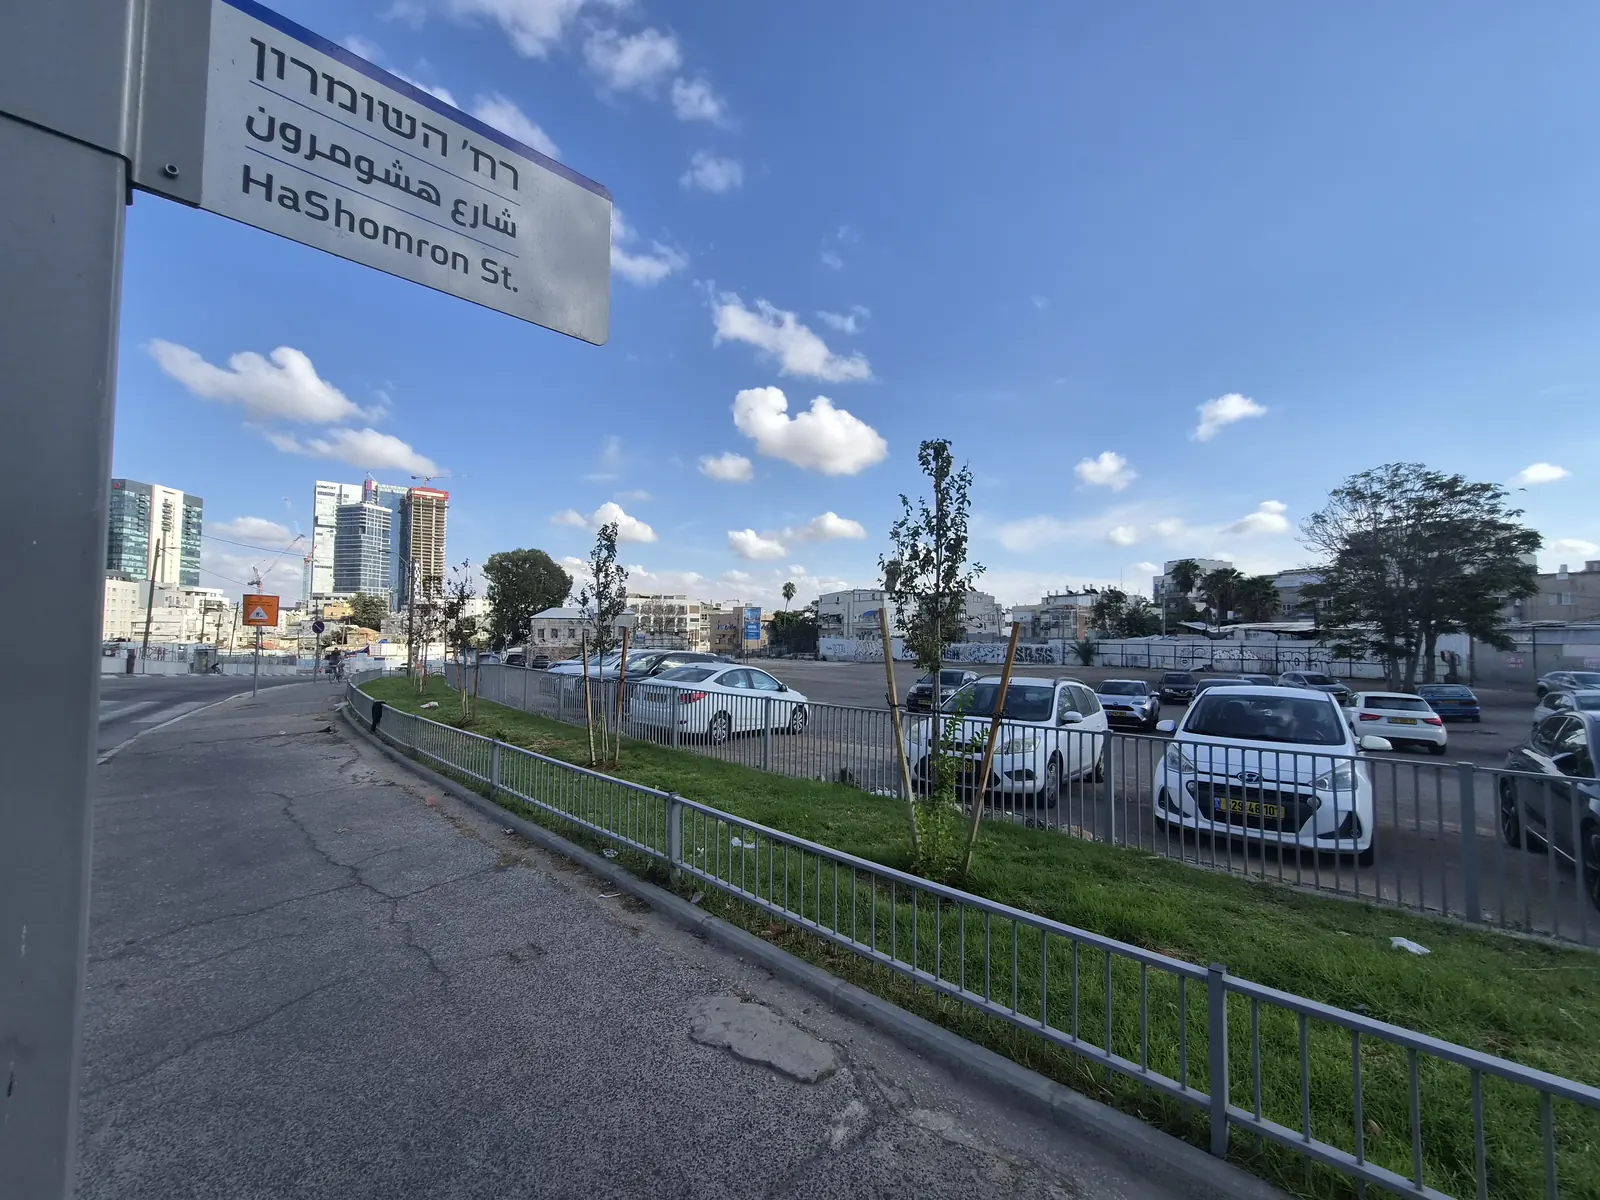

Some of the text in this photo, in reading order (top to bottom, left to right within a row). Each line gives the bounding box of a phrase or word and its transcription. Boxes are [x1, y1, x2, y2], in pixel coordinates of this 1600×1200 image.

[250, 36, 448, 158] השומרון
[242, 164, 519, 293] HaShomron St.
[245, 105, 517, 239] شارع هشومرون
